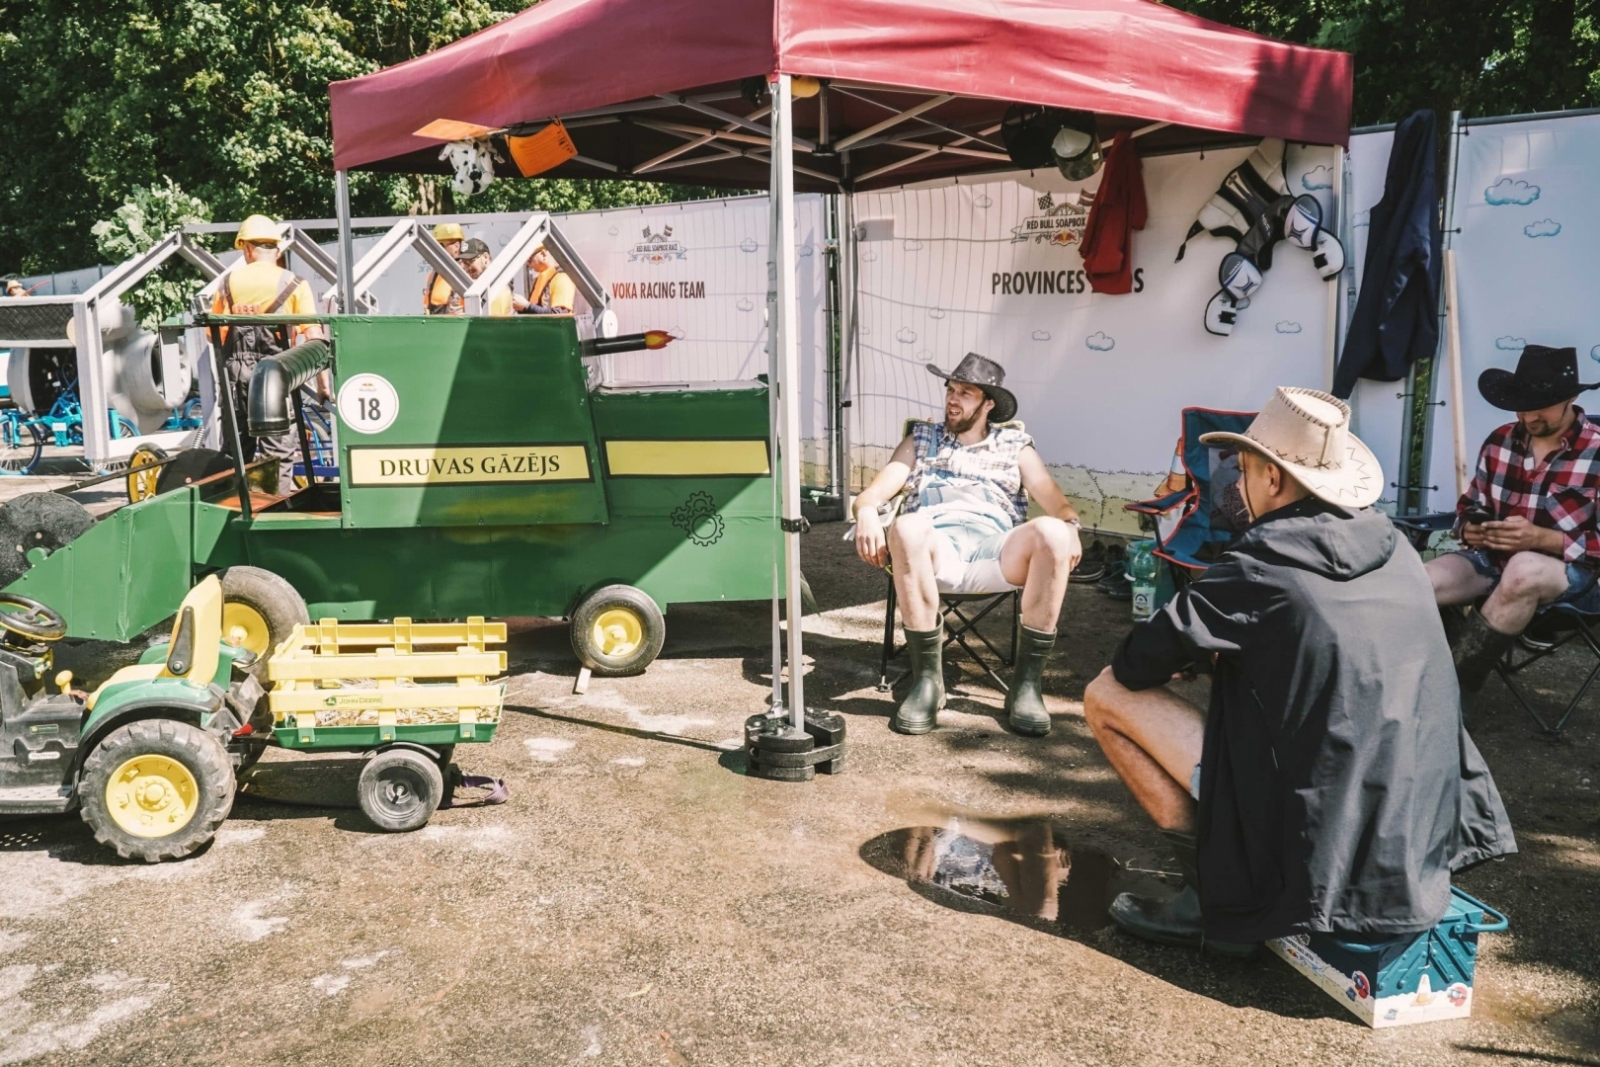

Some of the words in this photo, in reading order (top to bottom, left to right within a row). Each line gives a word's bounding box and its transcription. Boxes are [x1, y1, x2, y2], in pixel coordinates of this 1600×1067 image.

[1026, 220, 1039, 230] RED
[1040, 219, 1054, 229] BULL
[1055, 217, 1086, 228] SOAPBOX
[612, 282, 638, 299] VOKA
[640, 282, 676, 299] RACING
[679, 281, 705, 299] TEAM
[992, 270, 1085, 295] PROVINCES
[358, 398, 381, 421] 18
[379, 457, 475, 477] DRUVAS
[481, 453, 560, 476] GĀZĒJS
